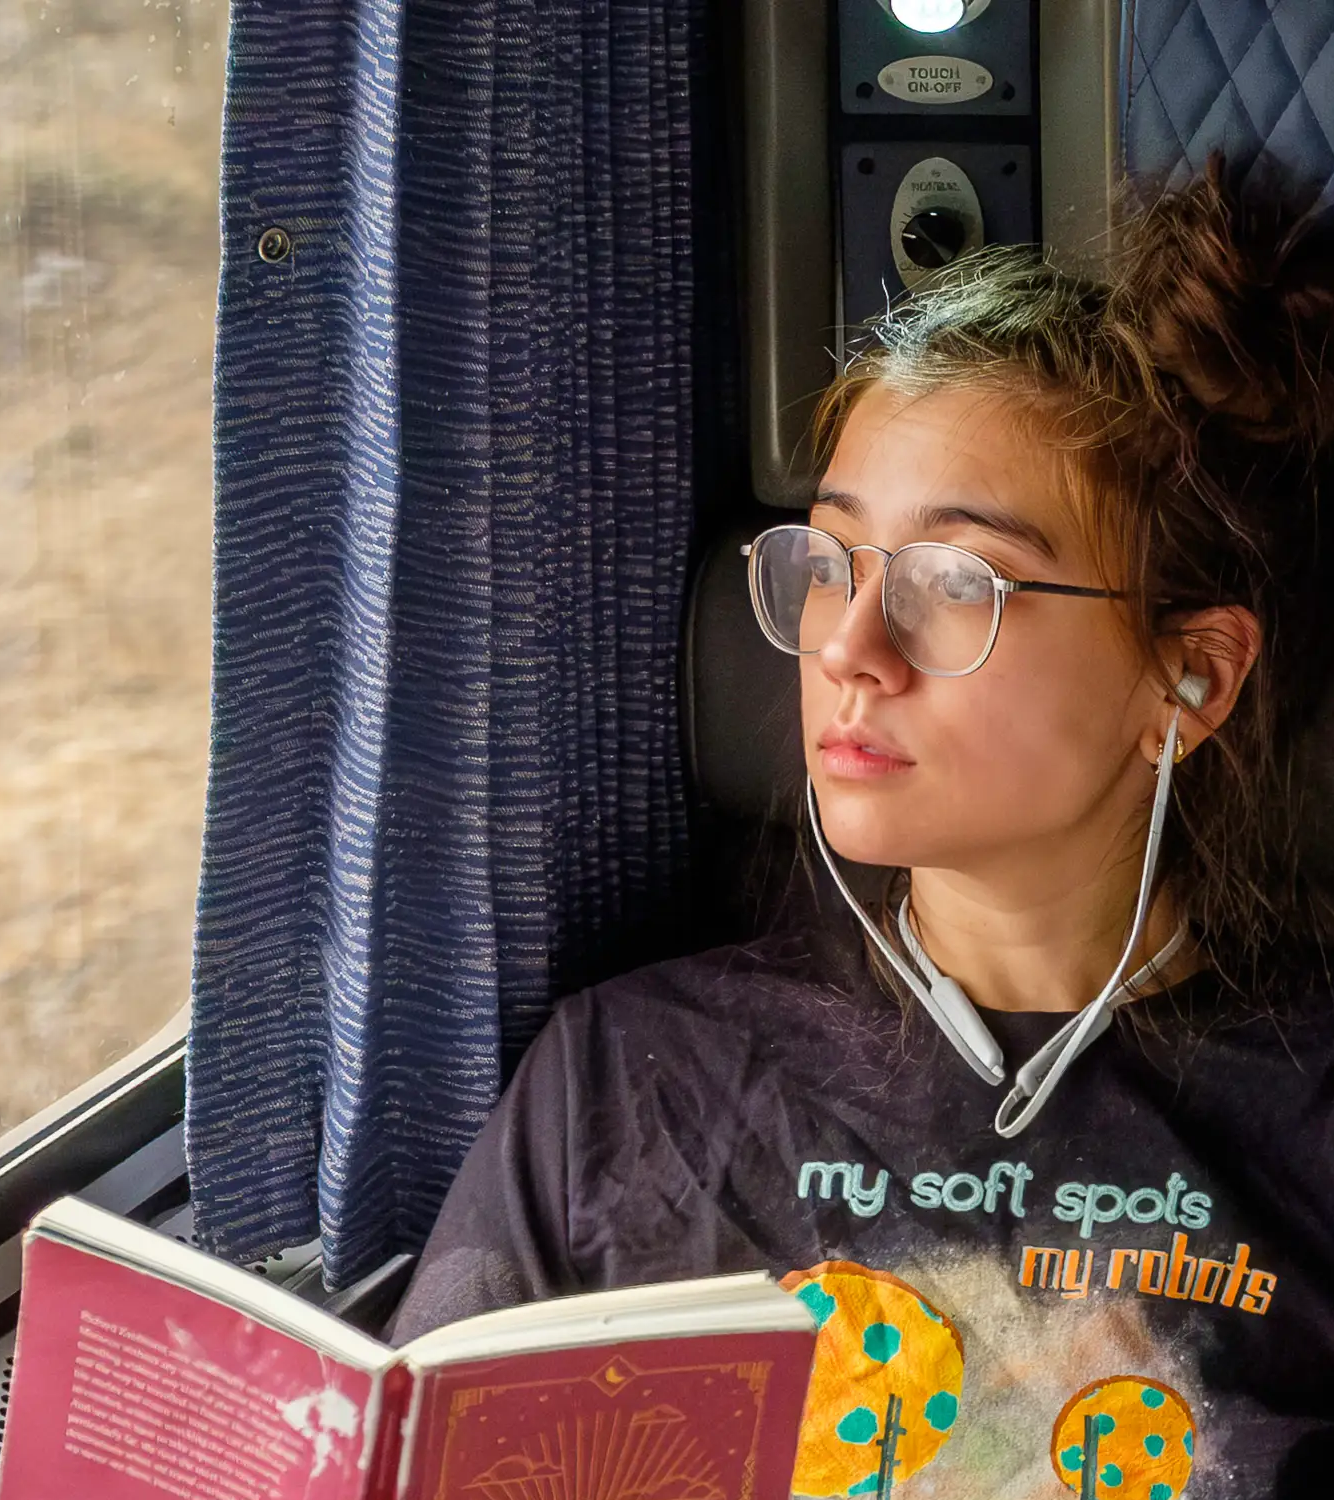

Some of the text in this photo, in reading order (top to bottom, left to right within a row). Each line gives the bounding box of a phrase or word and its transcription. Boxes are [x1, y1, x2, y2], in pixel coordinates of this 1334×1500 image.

[908, 65, 961, 80] TOUCH
[908, 81, 962, 94] ON-OFF
[798, 1160, 1213, 1239] my soft spots
[1019, 1232, 1278, 1315] my robots
